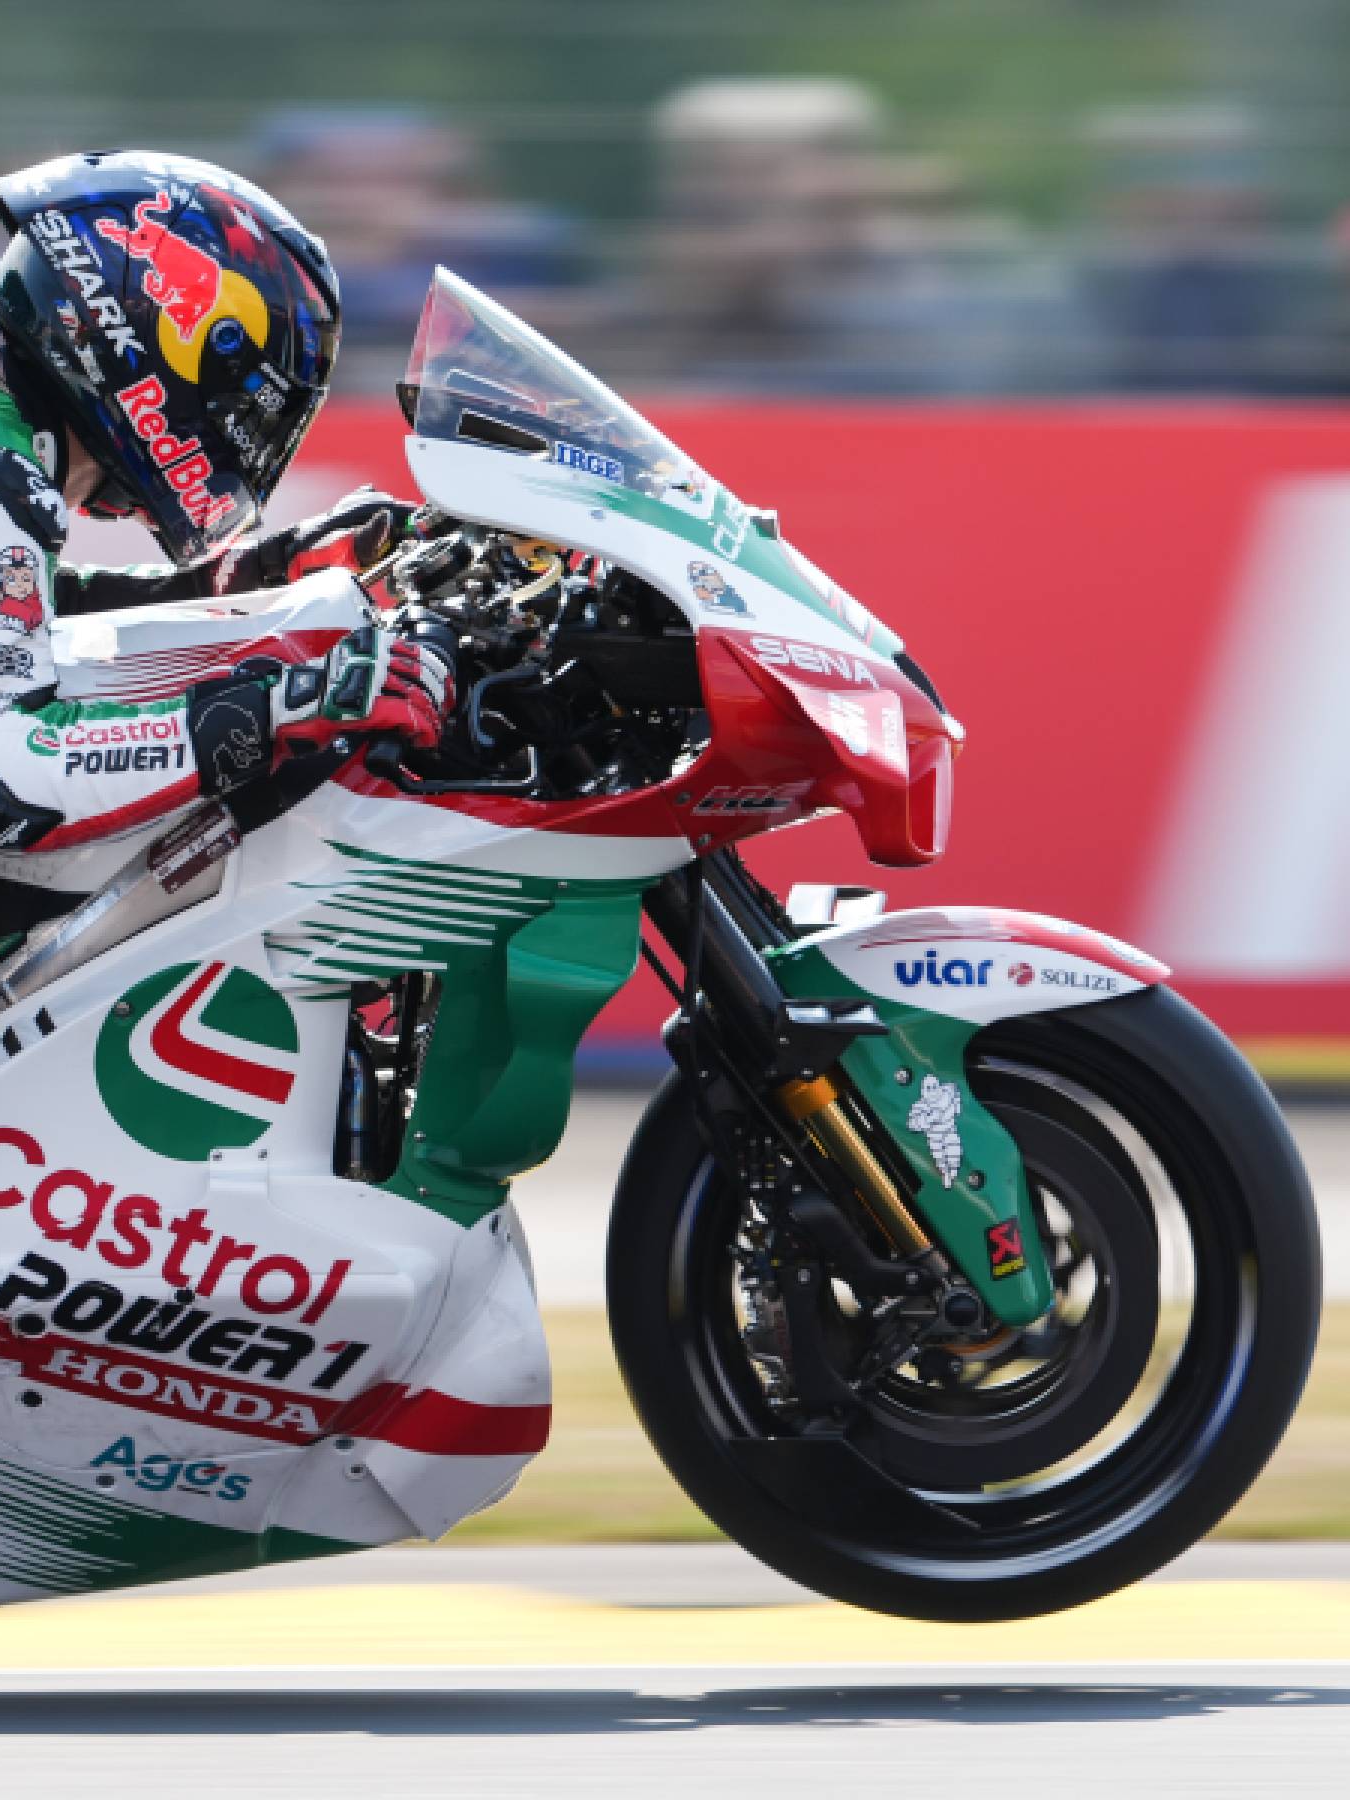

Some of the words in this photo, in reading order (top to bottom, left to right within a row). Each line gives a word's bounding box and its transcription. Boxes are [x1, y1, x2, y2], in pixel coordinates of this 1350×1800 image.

[40, 209, 147, 357] SHARK
[752, 635, 881, 689] SENA
[65, 716, 180, 746] Castrol
[65, 743, 187, 777] POWER1
[1040, 968, 1120, 993] SOLIZE
[43, 1347, 322, 1435] HONDA
